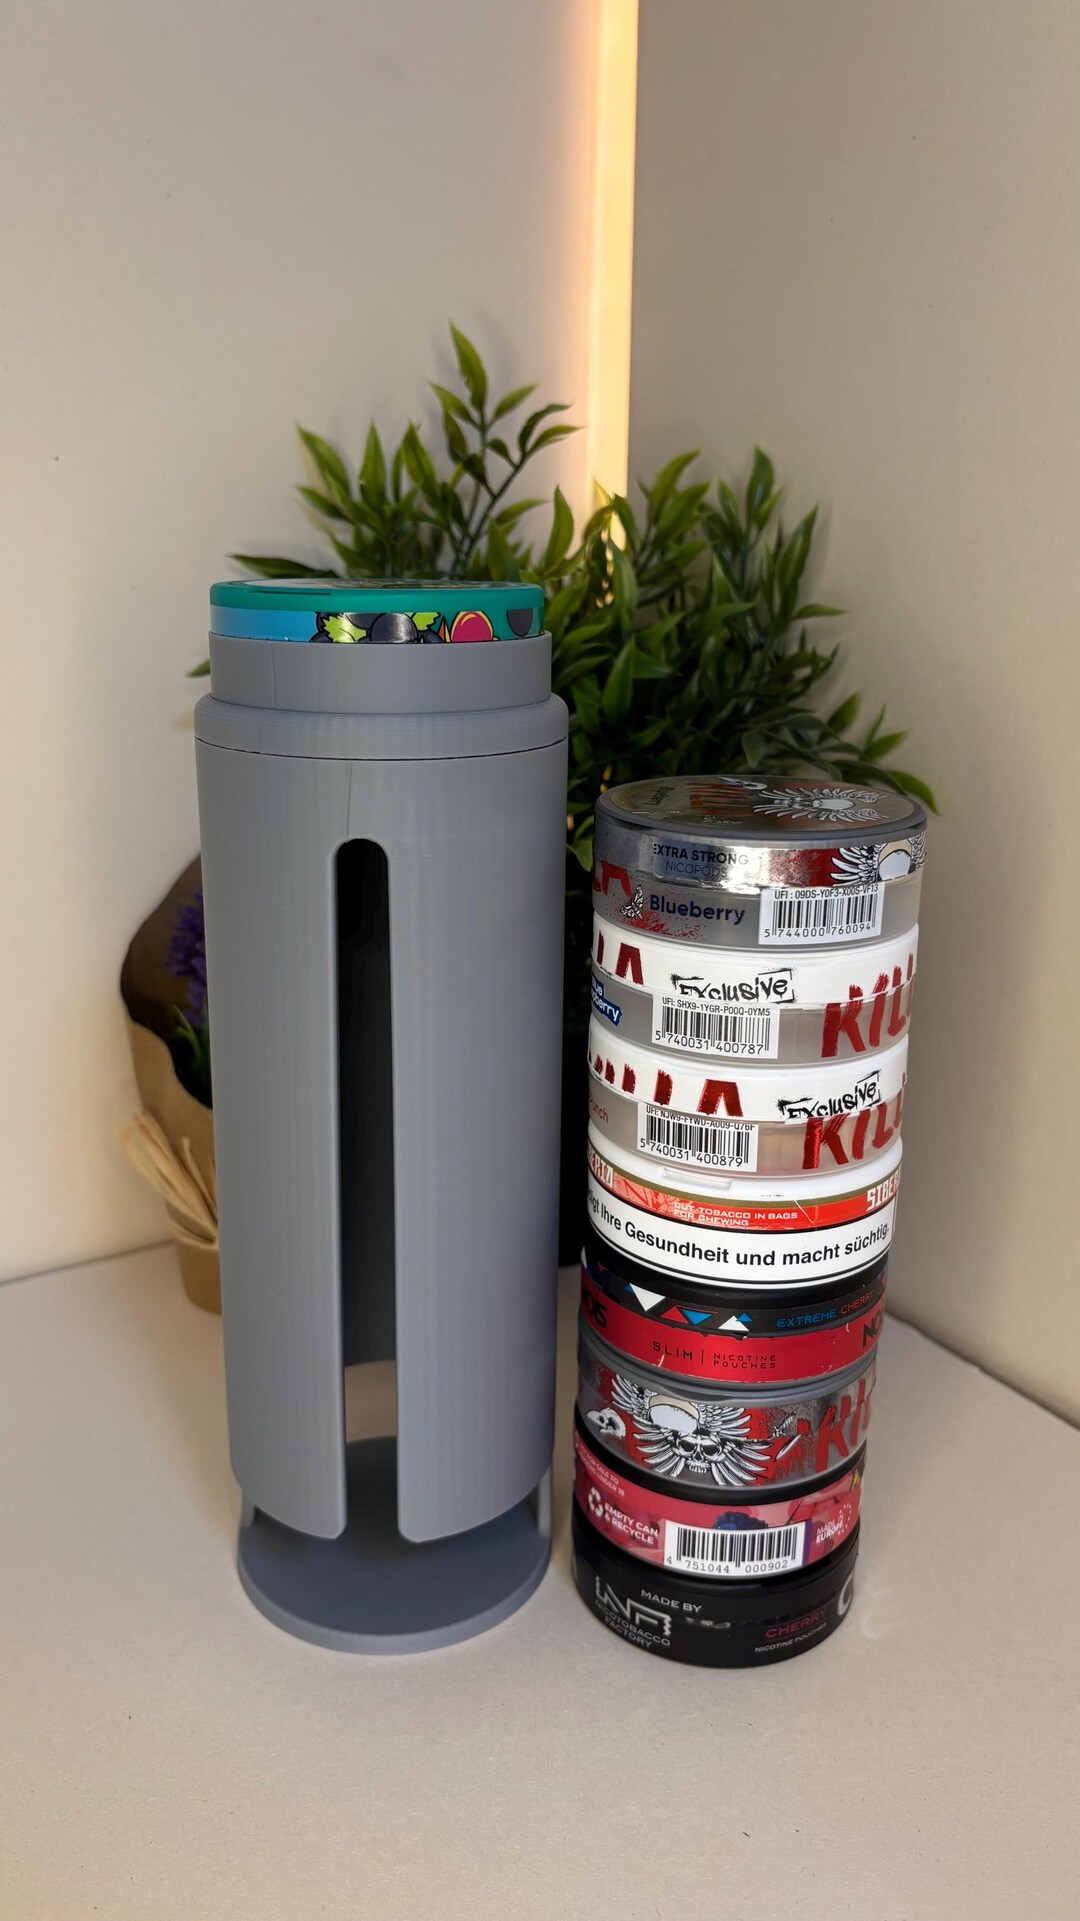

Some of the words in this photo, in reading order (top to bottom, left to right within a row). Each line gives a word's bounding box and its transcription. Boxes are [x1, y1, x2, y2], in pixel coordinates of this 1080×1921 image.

[653, 843, 688, 859] EXTRA
[691, 850, 749, 865] STRONG
[665, 861, 729, 878] NICOPODS
[650, 894, 746, 925] Blueberry
[764, 929, 771, 938] 5
[778, 927, 825, 938] 744000
[831, 922, 871, 935] 760094
[655, 1030, 661, 1040] 5
[667, 1033, 709, 1050] 740031
[716, 1042, 764, 1054] 400787
[640, 1138, 646, 1148] 5
[650, 1141, 689, 1160] 740031
[696, 1153, 743, 1167] 400879
[673, 1209, 694, 1220] FOR
[698, 1213, 749, 1226] CHEWING
[698, 1207, 751, 1219] TOBACCO
[601, 1202, 622, 1230] Ihre
[625, 1221, 729, 1264] Gesundheit
[736, 1250, 776, 1266] und
[782, 1243, 840, 1266] macht
[844, 1223, 889, 1255] süchtig.
[777, 1308, 838, 1329] EXTREME
[840, 1290, 874, 1314] CHERRY
[653, 1341, 693, 1361] SLIM
[713, 1353, 776, 1362] NICOTINE
[713, 1360, 776, 1370] POUCHES
[604, 1502, 634, 1525] EMPTY
[636, 1520, 658, 1537] CAN
[612, 1517, 654, 1544] RECYCLE
[666, 1556, 673, 1565] 4
[685, 1559, 730, 1573] 751044
[745, 1559, 788, 1573] 000902
[641, 1589, 680, 1609] MADE
[683, 1602, 702, 1613] BY
[765, 1609, 827, 1639] CHERRY
[755, 1637, 793, 1653] NICOTINE
